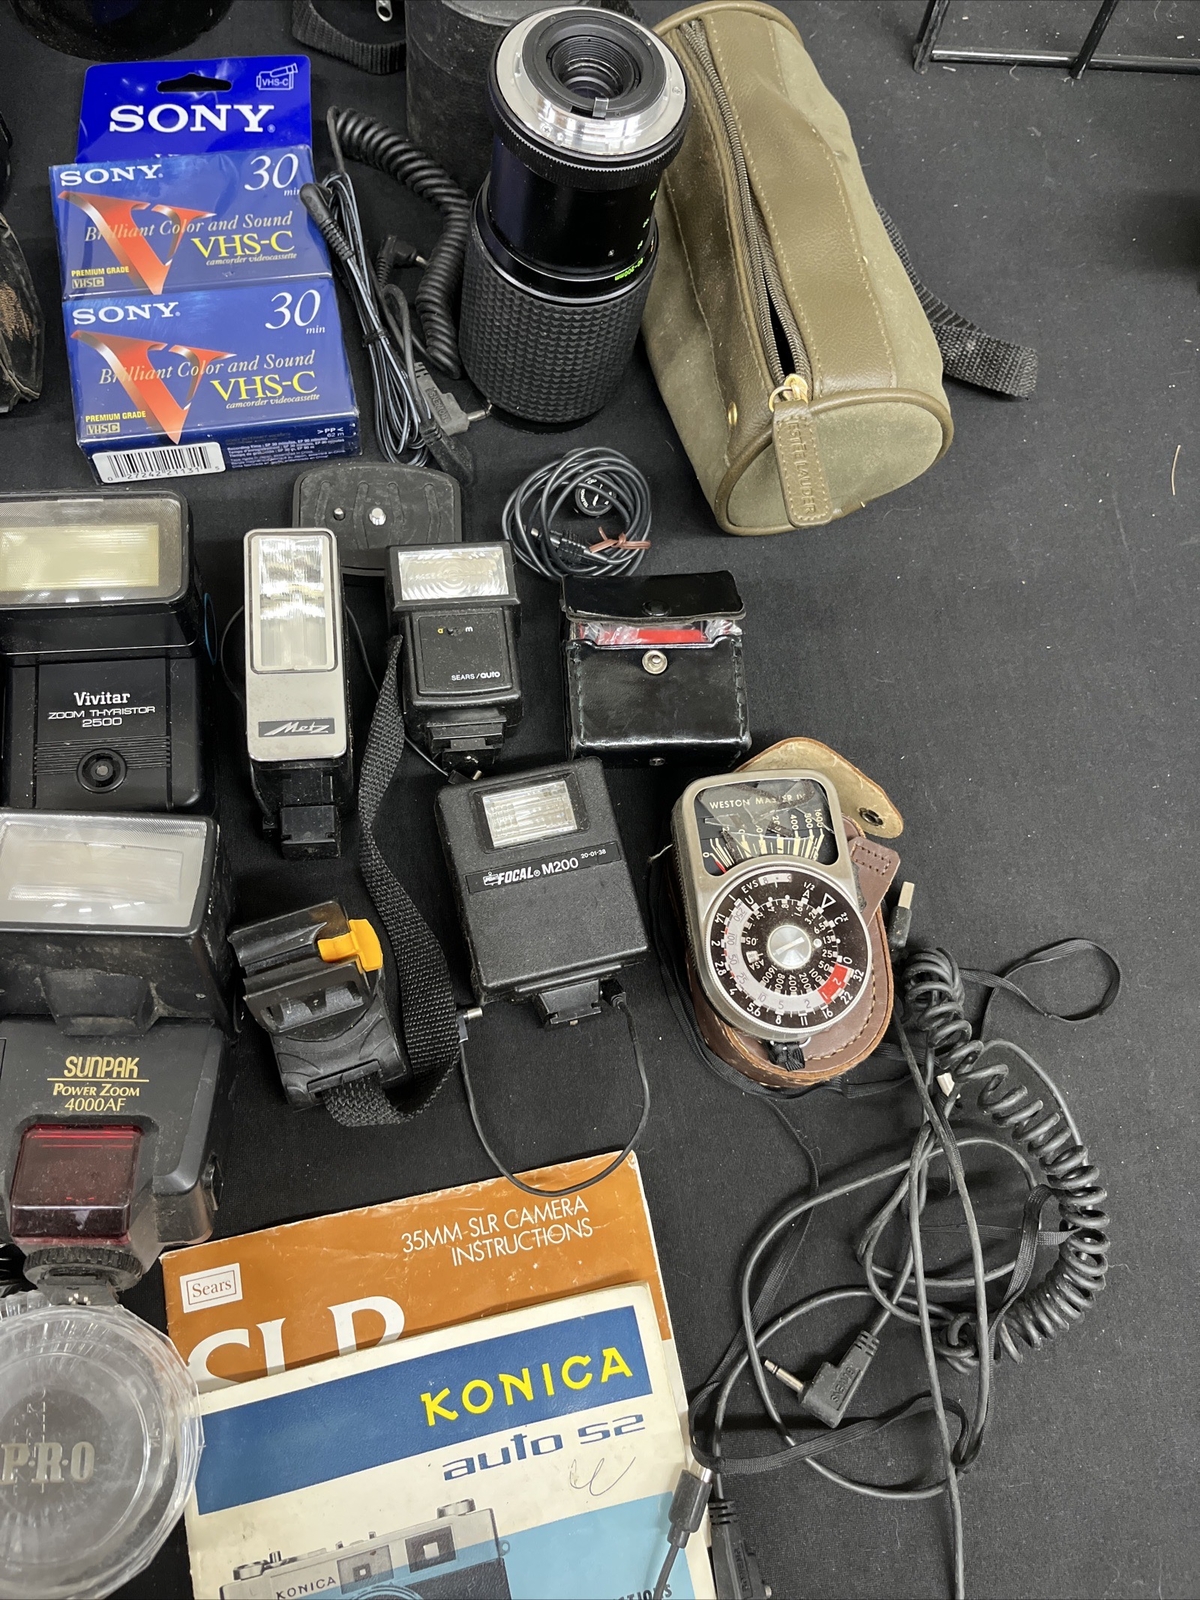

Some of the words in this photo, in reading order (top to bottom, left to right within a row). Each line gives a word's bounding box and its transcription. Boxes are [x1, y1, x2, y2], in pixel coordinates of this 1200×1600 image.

[262, 78, 289, 87] VHS-C
[110, 103, 275, 133] SONY
[60, 164, 162, 187] SONY
[244, 153, 299, 191] 30
[85, 222, 155, 242] Brilliant
[159, 218, 204, 235] Color
[207, 214, 238, 232] and
[242, 211, 293, 228] Sound
[191, 231, 296, 258] VHS-C
[206, 257, 247, 266] camcorder
[248, 251, 297, 262] videocassette
[71, 268, 105, 277] PREMIUM
[106, 265, 130, 275] GRADE
[72, 301, 180, 326] SONY
[265, 289, 321, 330] 30
[306, 324, 326, 335] min
[99, 364, 173, 385] Brilliant
[178, 360, 224, 378] Color
[228, 355, 259, 373] and
[263, 350, 315, 370] Sound
[210, 371, 318, 402] VHS-C
[226, 398, 269, 410] camcorder
[269, 393, 320, 405] videocassette
[85, 413, 120, 423] PREMIUM
[122, 410, 146, 420] GRADE
[795, 461, 818, 515] LAUDER
[73, 690, 131, 707] Vivitar
[48, 710, 86, 721] ZOOM
[89, 706, 156, 718] THYRISTOR
[82, 716, 123, 729] 2500
[264, 721, 331, 737] Metz
[709, 799, 750, 810] WESTON
[790, 814, 799, 830] 400
[541, 857, 579, 875] M200
[741, 879, 759, 894] EVS
[821, 949, 833, 958] 25
[714, 961, 727, 976] 2.8
[818, 960, 830, 971] 50
[774, 973, 786, 990] 800
[788, 974, 797, 992] 400
[798, 972, 812, 990] 200
[808, 967, 823, 984] 100
[852, 968, 865, 982] 32
[729, 987, 738, 996] 4
[840, 991, 853, 1005] 22
[746, 1002, 761, 1017] 5.6
[822, 1008, 834, 1020] 16
[775, 1014, 782, 1025] 8
[63, 1055, 140, 1078] SUNPAK
[99, 1084, 140, 1097] ZOOM
[64, 1097, 127, 1112] 4000AF
[503, 1195, 589, 1230] CAMERA
[451, 1217, 594, 1267] INSTRUCTIONS
[191, 1276, 233, 1299] Sears
[420, 1347, 633, 1428] KONICA
[442, 1431, 564, 1482] auto
[578, 1413, 646, 1446] S2
[276, 1576, 337, 1600] KONICA
